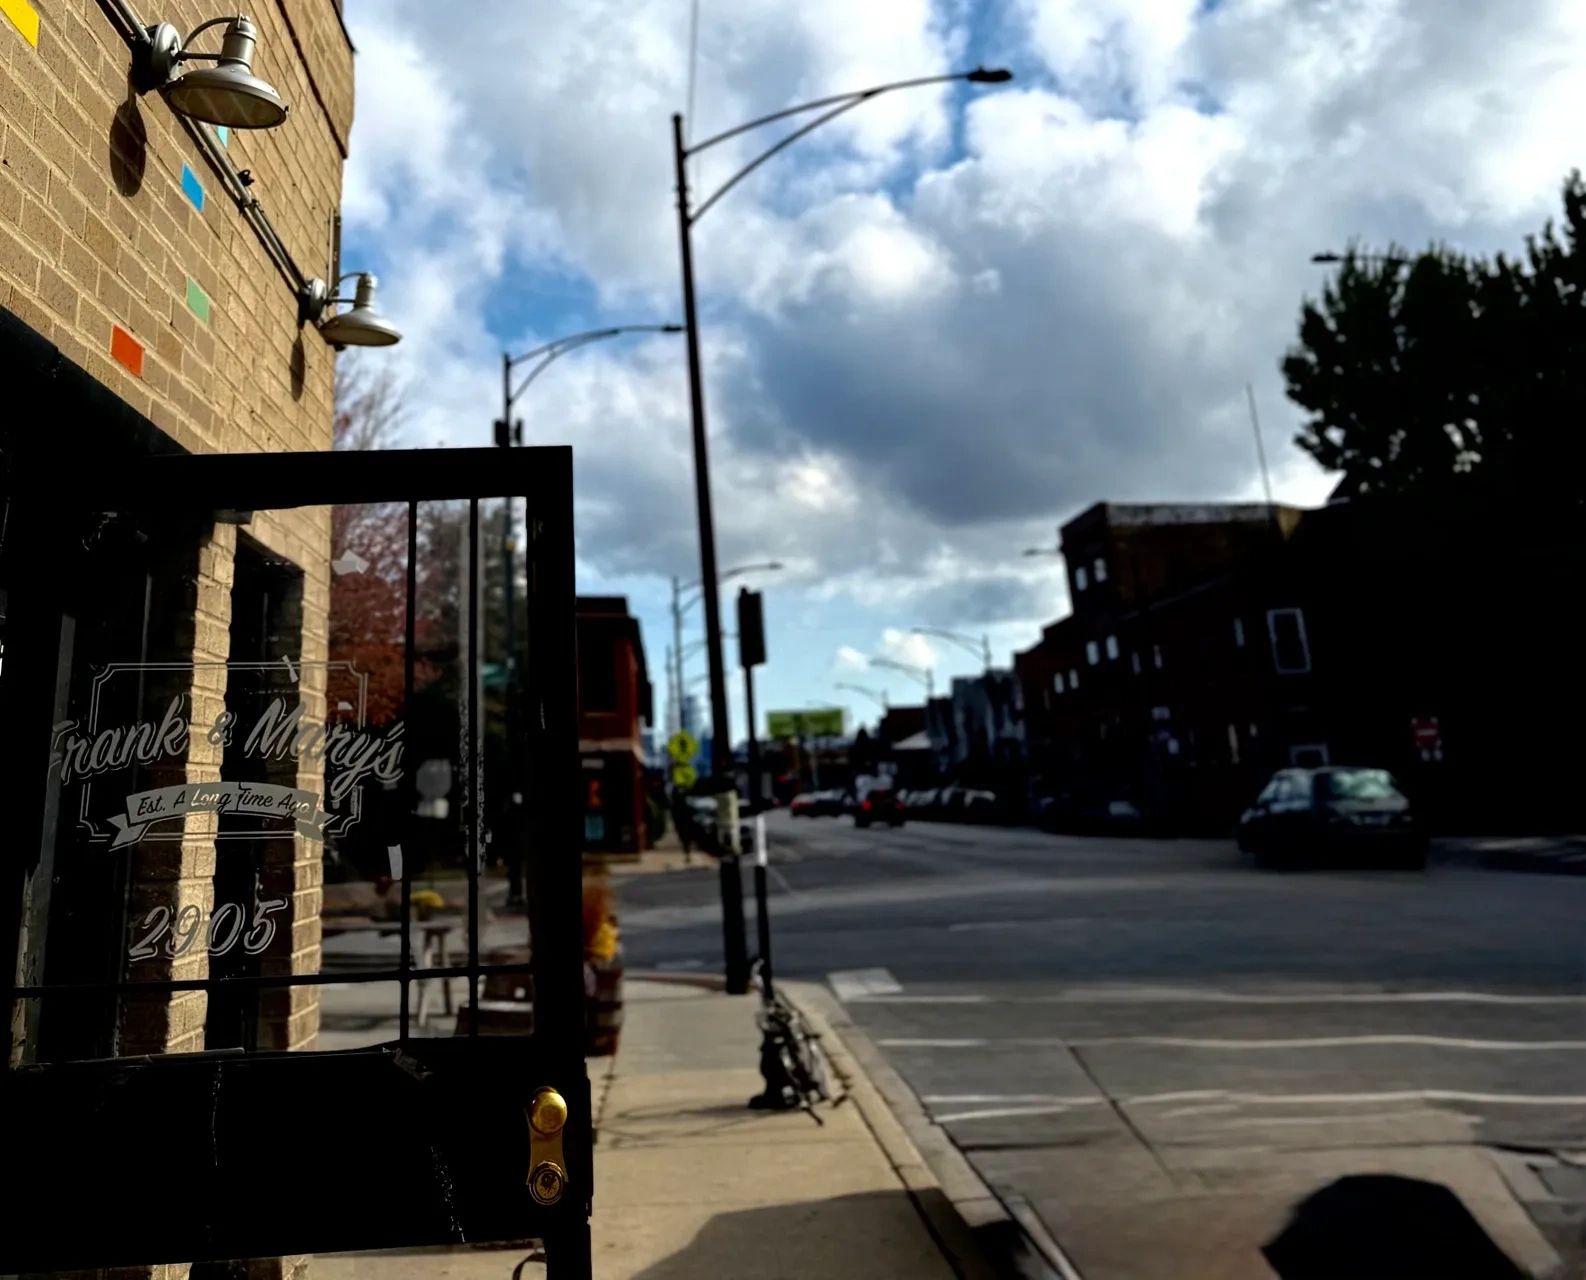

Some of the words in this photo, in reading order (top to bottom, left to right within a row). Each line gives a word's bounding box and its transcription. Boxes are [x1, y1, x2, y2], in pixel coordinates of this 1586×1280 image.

[207, 711, 238, 747] &
[243, 696, 405, 801] Mary's
[137, 796, 166, 816] Est.
[173, 790, 186, 809] A
[189, 788, 232, 812] Long
[236, 784, 273, 810] Time
[277, 793, 310, 818] Ago
[128, 897, 289, 962] 2905
